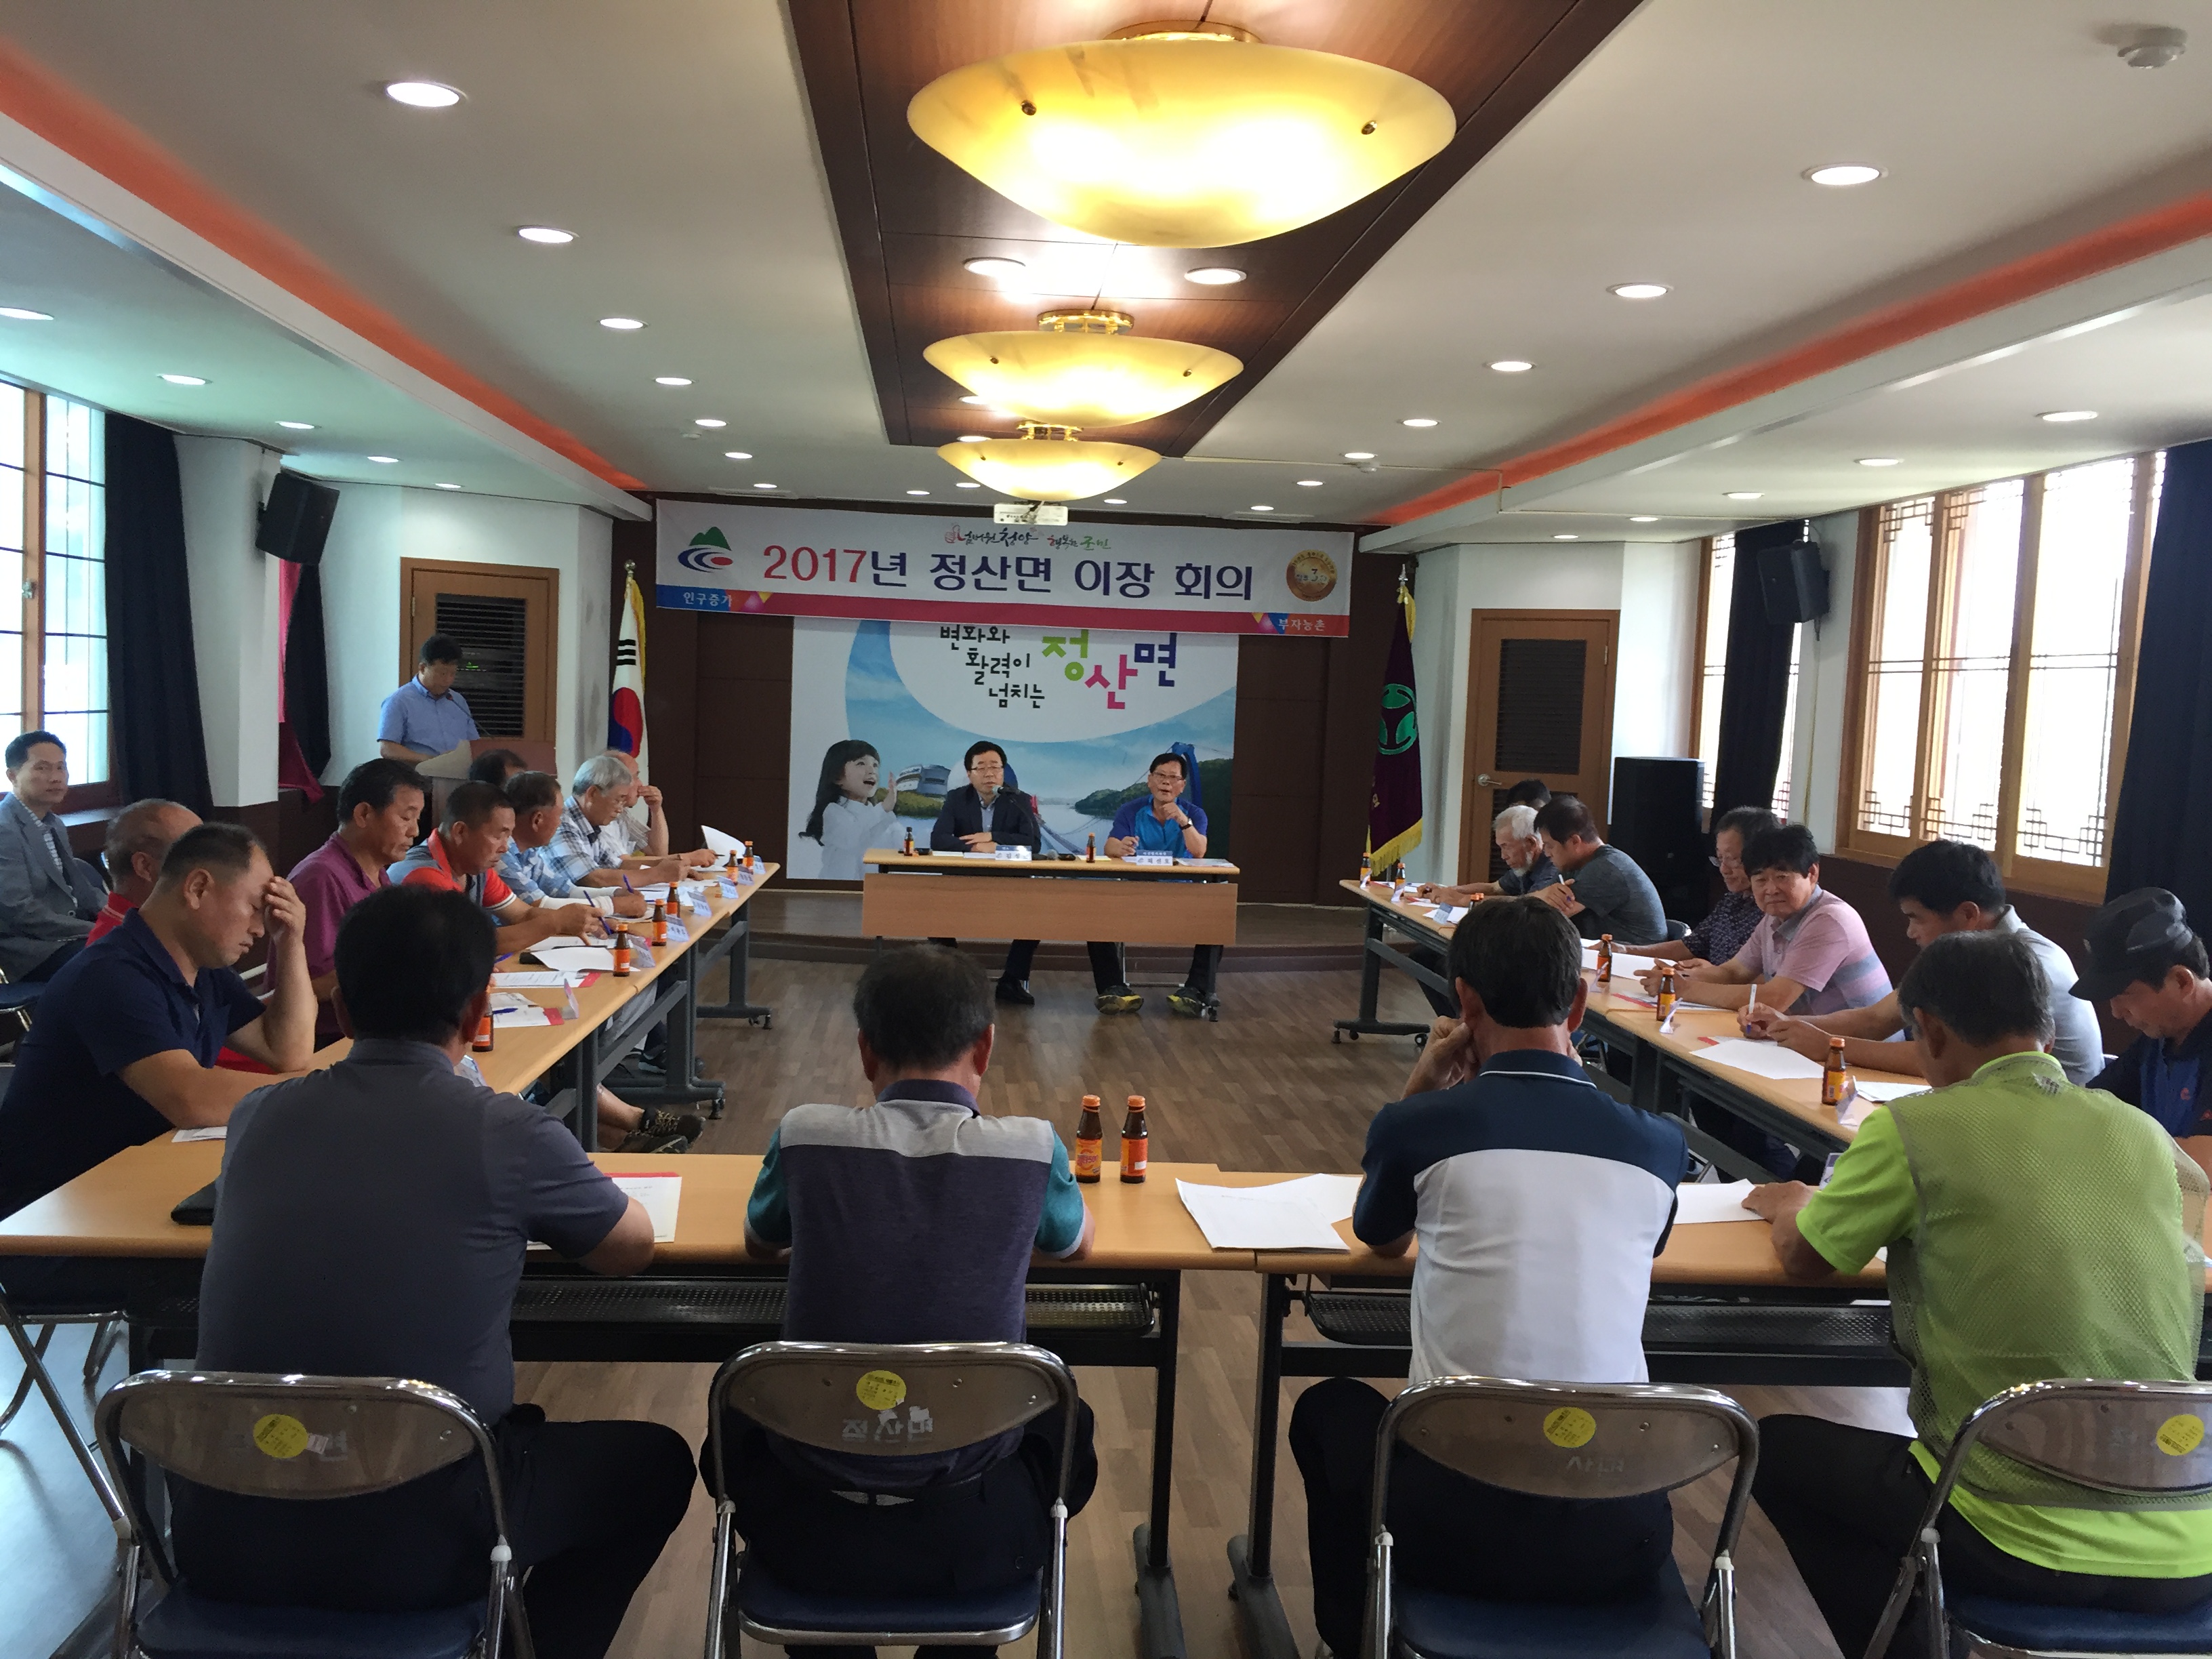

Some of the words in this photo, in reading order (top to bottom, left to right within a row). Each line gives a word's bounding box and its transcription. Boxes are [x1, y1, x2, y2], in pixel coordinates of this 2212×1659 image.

[999, 527, 1039, 547] 청양
[763, 545, 907, 588] 2017년
[929, 554, 1051, 593] 정산면
[1074, 560, 1155, 598] 이장
[1174, 562, 1252, 600] 회의
[682, 591, 733, 607] 인구증가
[940, 623, 1010, 651] 변화와
[1278, 618, 1326, 632] 부자농촌
[965, 647, 1031, 685] 활력이
[1042, 629, 1178, 710] 정산면
[988, 682, 1045, 709] 넘치는
